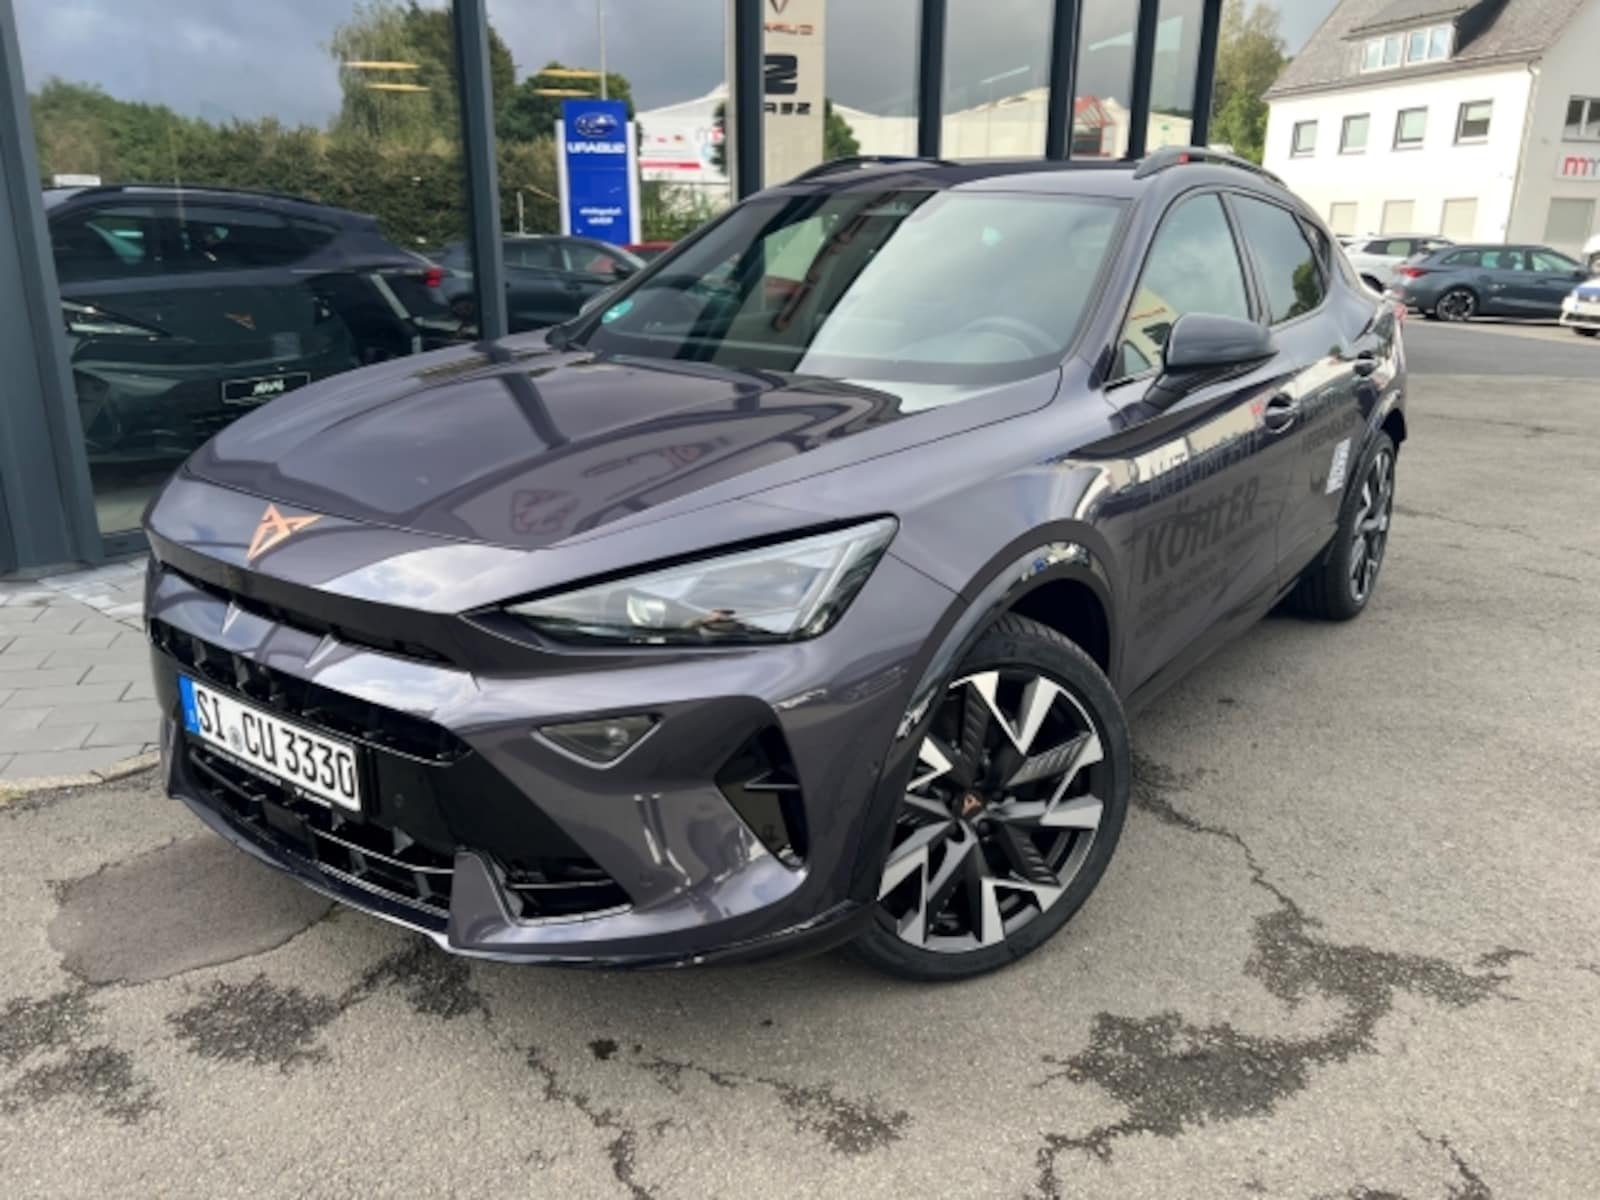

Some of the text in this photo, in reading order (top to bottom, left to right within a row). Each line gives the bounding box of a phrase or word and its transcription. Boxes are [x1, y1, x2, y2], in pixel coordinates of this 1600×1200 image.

[197, 690, 226, 741] SI
[242, 711, 278, 767] CU
[281, 727, 355, 799] 3330
